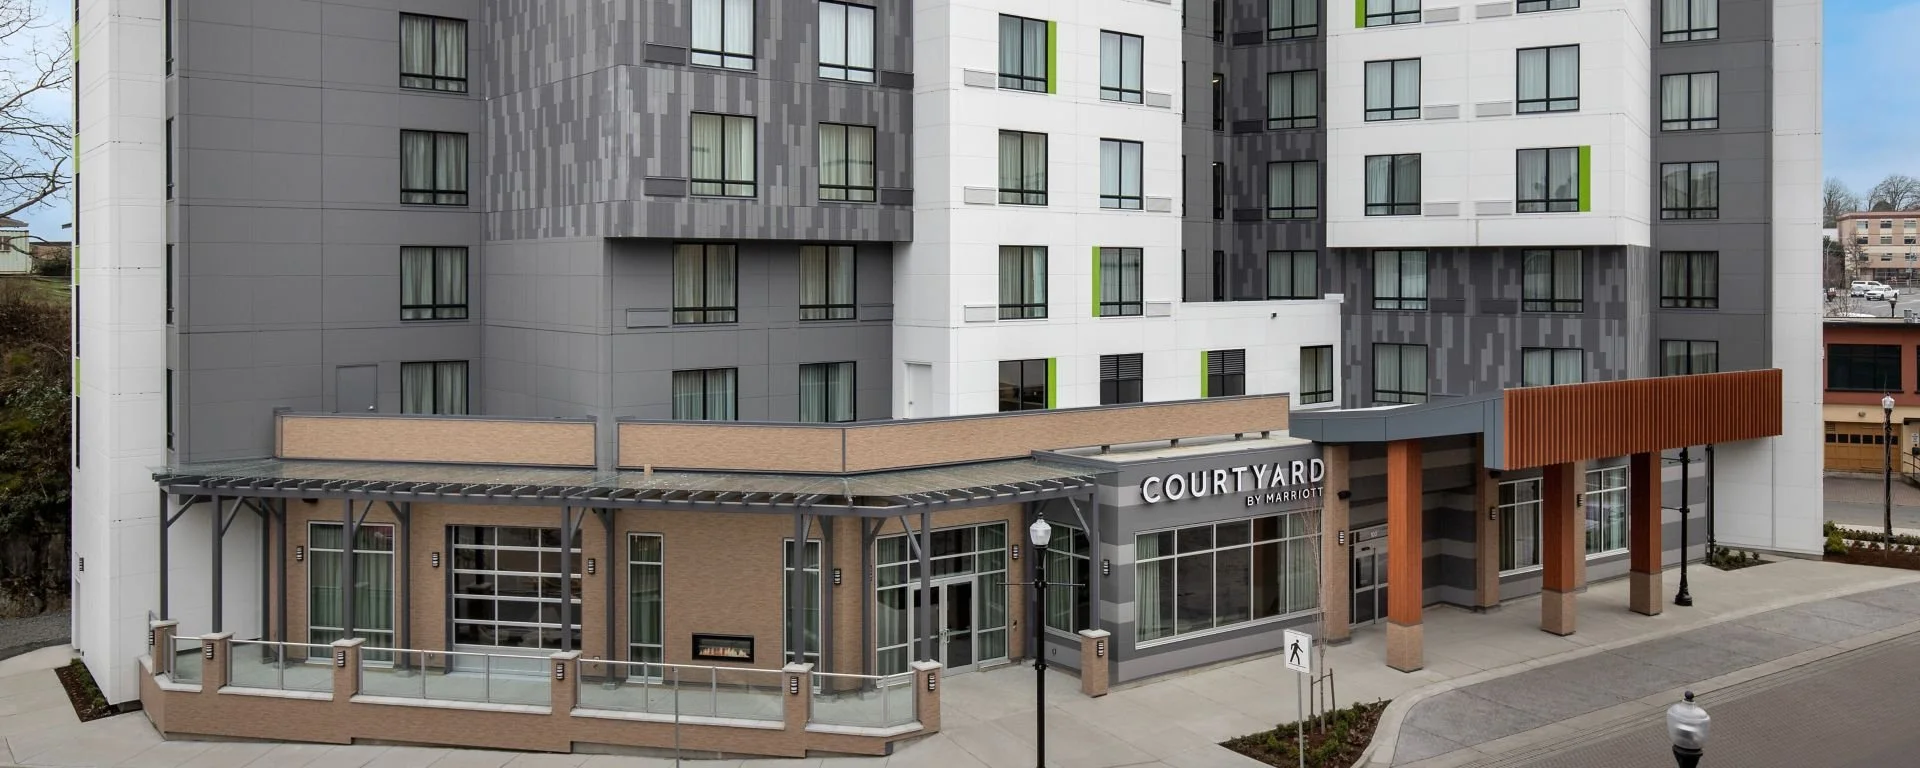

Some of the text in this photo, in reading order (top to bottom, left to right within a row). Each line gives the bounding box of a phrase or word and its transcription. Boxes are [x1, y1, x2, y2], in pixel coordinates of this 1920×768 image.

[1141, 458, 1325, 504] COURTYARD
[1247, 486, 1324, 507] BY MARRIOTT
